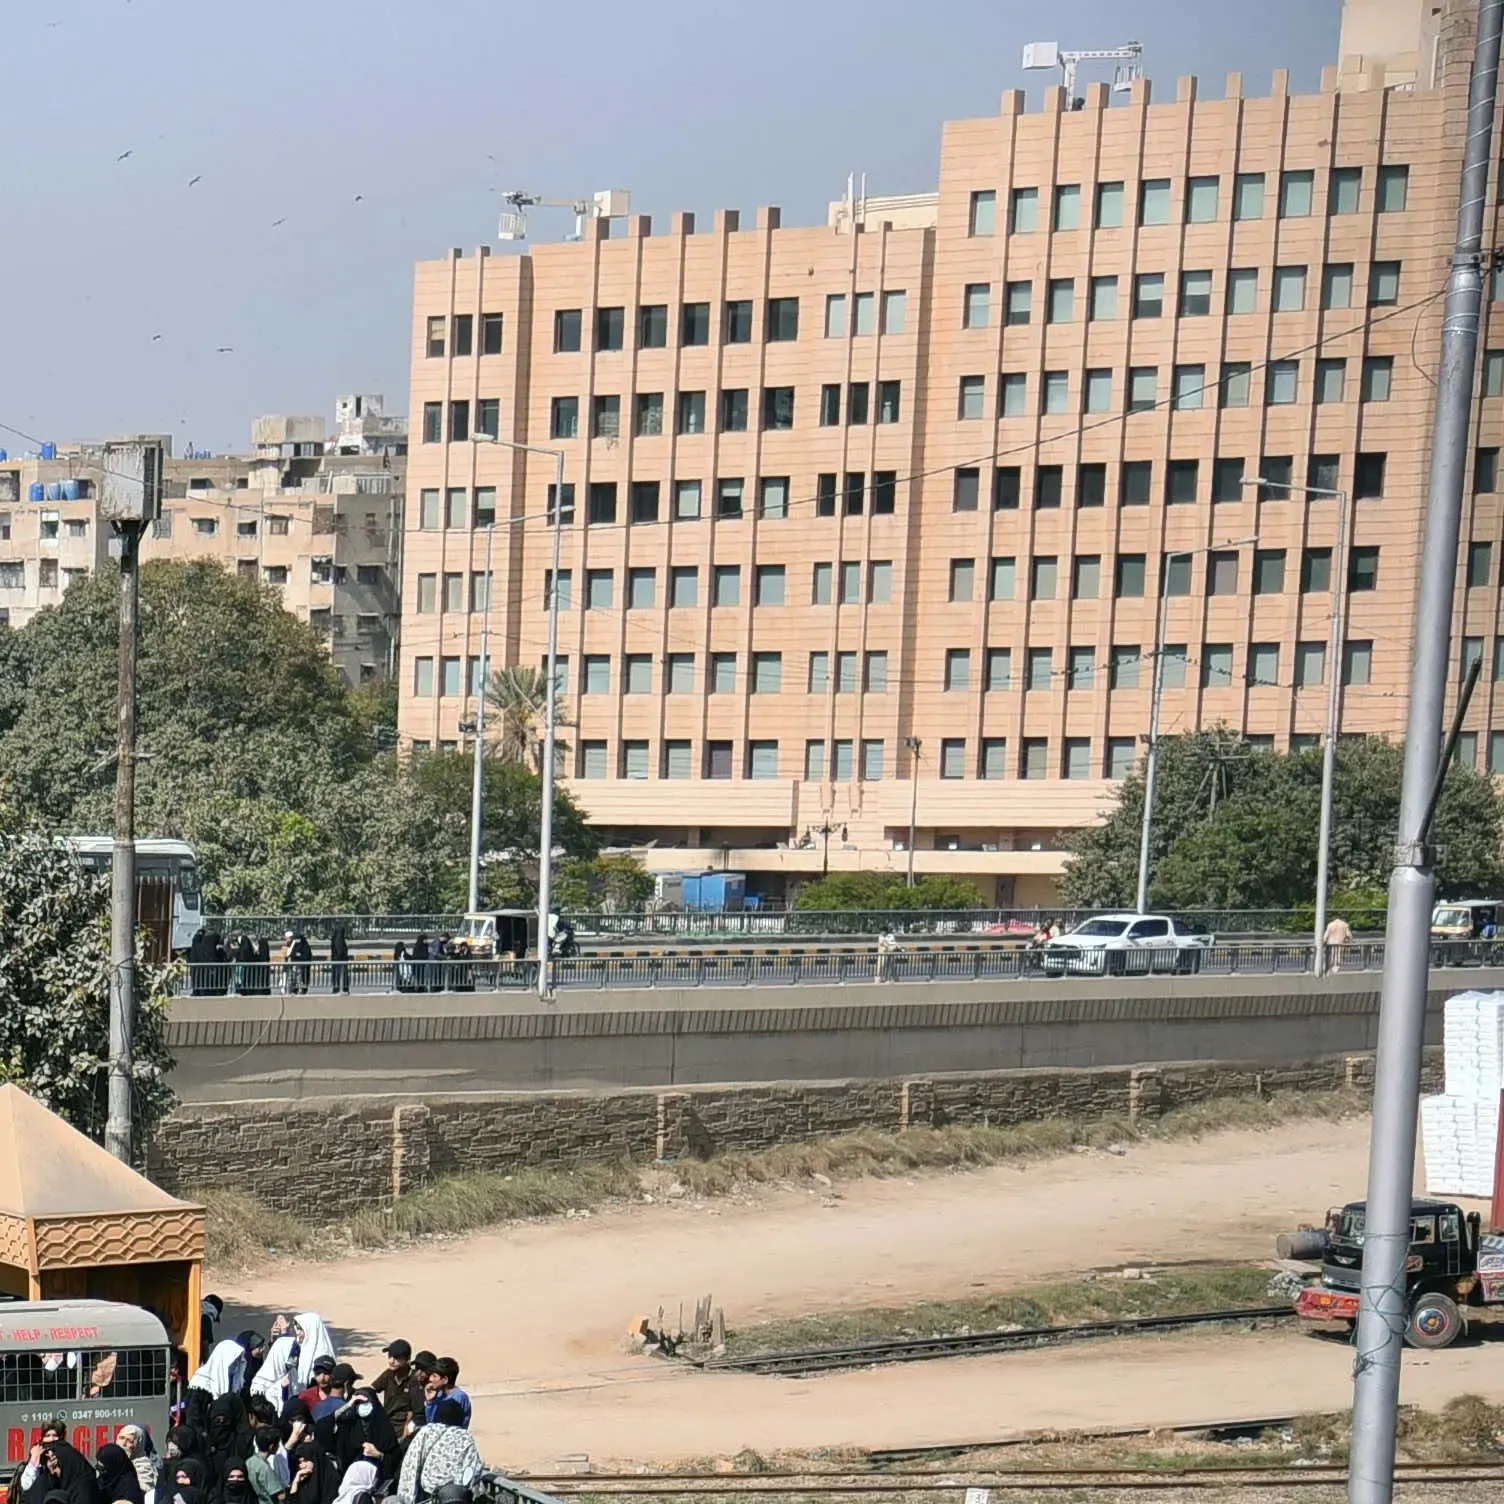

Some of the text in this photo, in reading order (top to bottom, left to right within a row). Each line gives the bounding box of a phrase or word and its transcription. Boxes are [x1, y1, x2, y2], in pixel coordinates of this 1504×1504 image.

[12, 1328, 41, 1342] HELP
[49, 1326, 99, 1341] RESPECT
[31, 1412, 53, 1421] 1101
[72, 1410, 93, 1421] 0347
